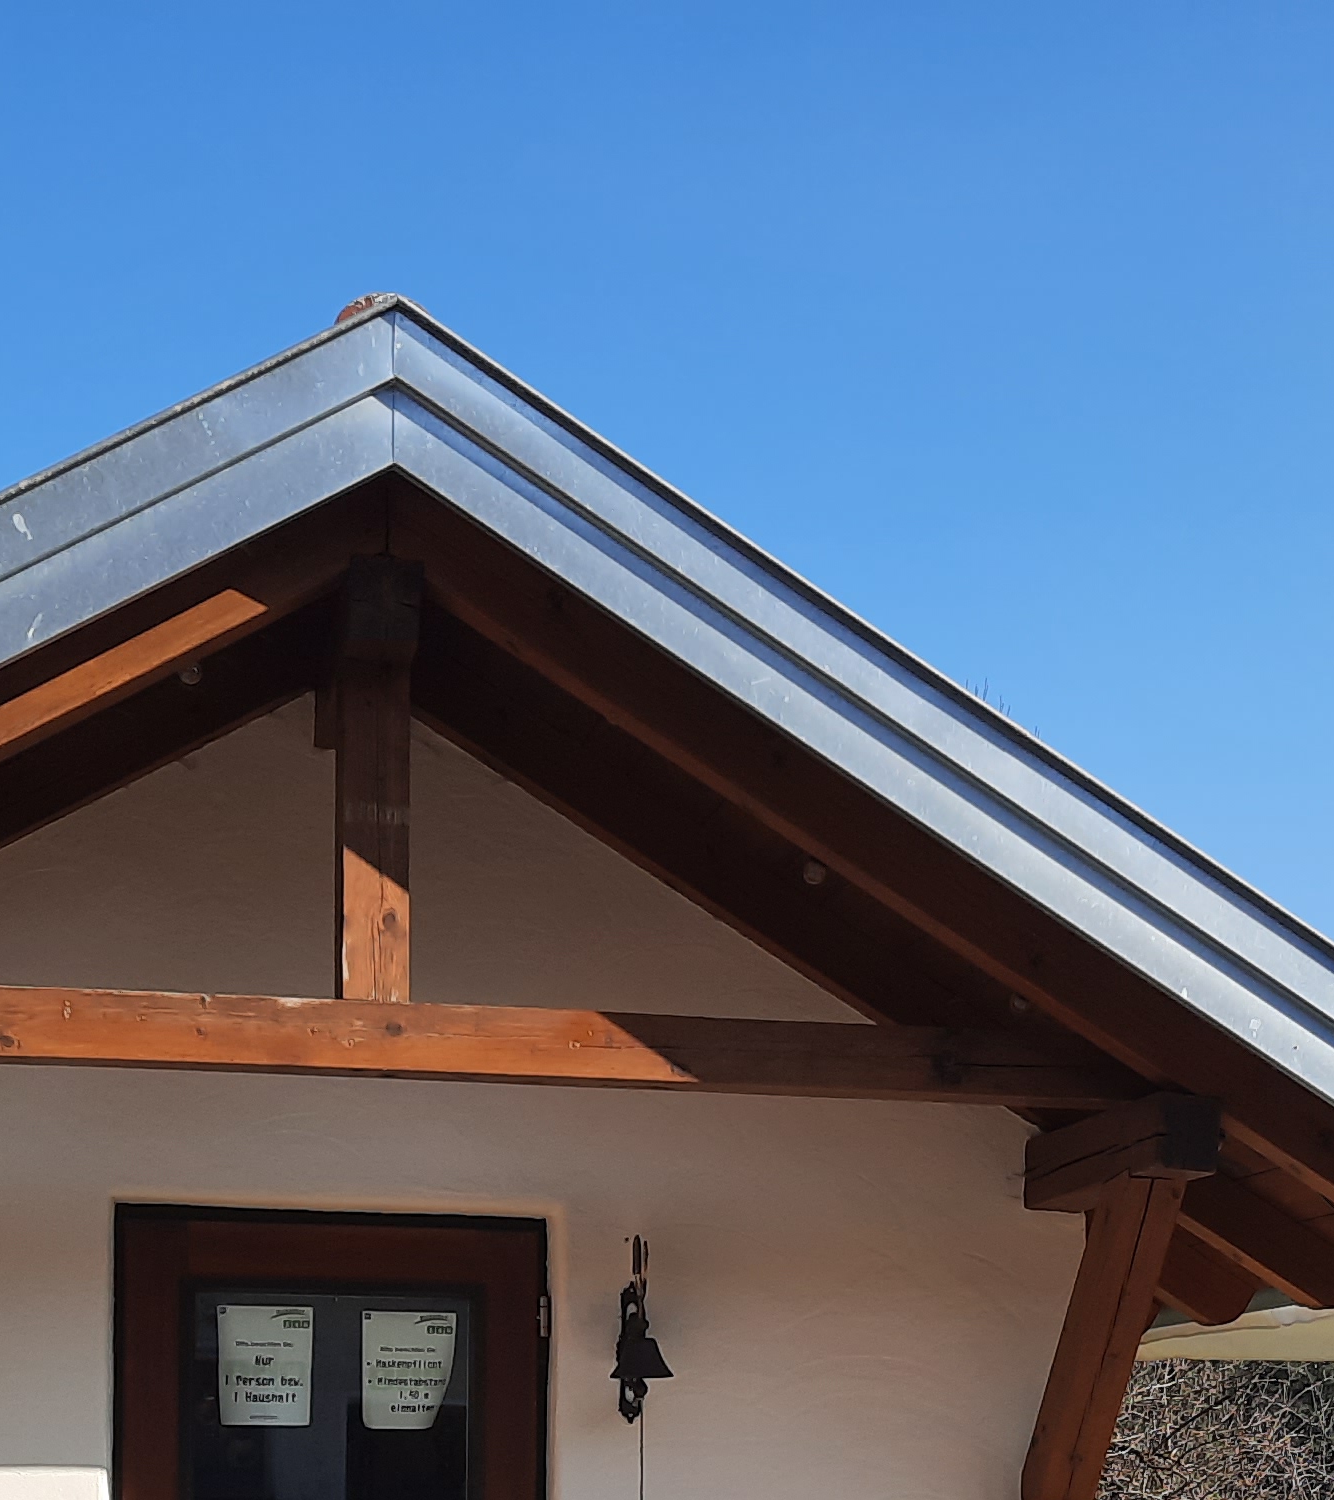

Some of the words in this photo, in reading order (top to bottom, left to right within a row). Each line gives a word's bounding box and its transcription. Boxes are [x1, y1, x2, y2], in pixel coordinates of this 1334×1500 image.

[254, 1355, 275, 1366] Nur
[375, 1358, 442, 1369] Maskenpflicht
[235, 1375, 275, 1387] Person
[280, 1375, 304, 1387] bzw.
[245, 1391, 297, 1403] Haushalt
